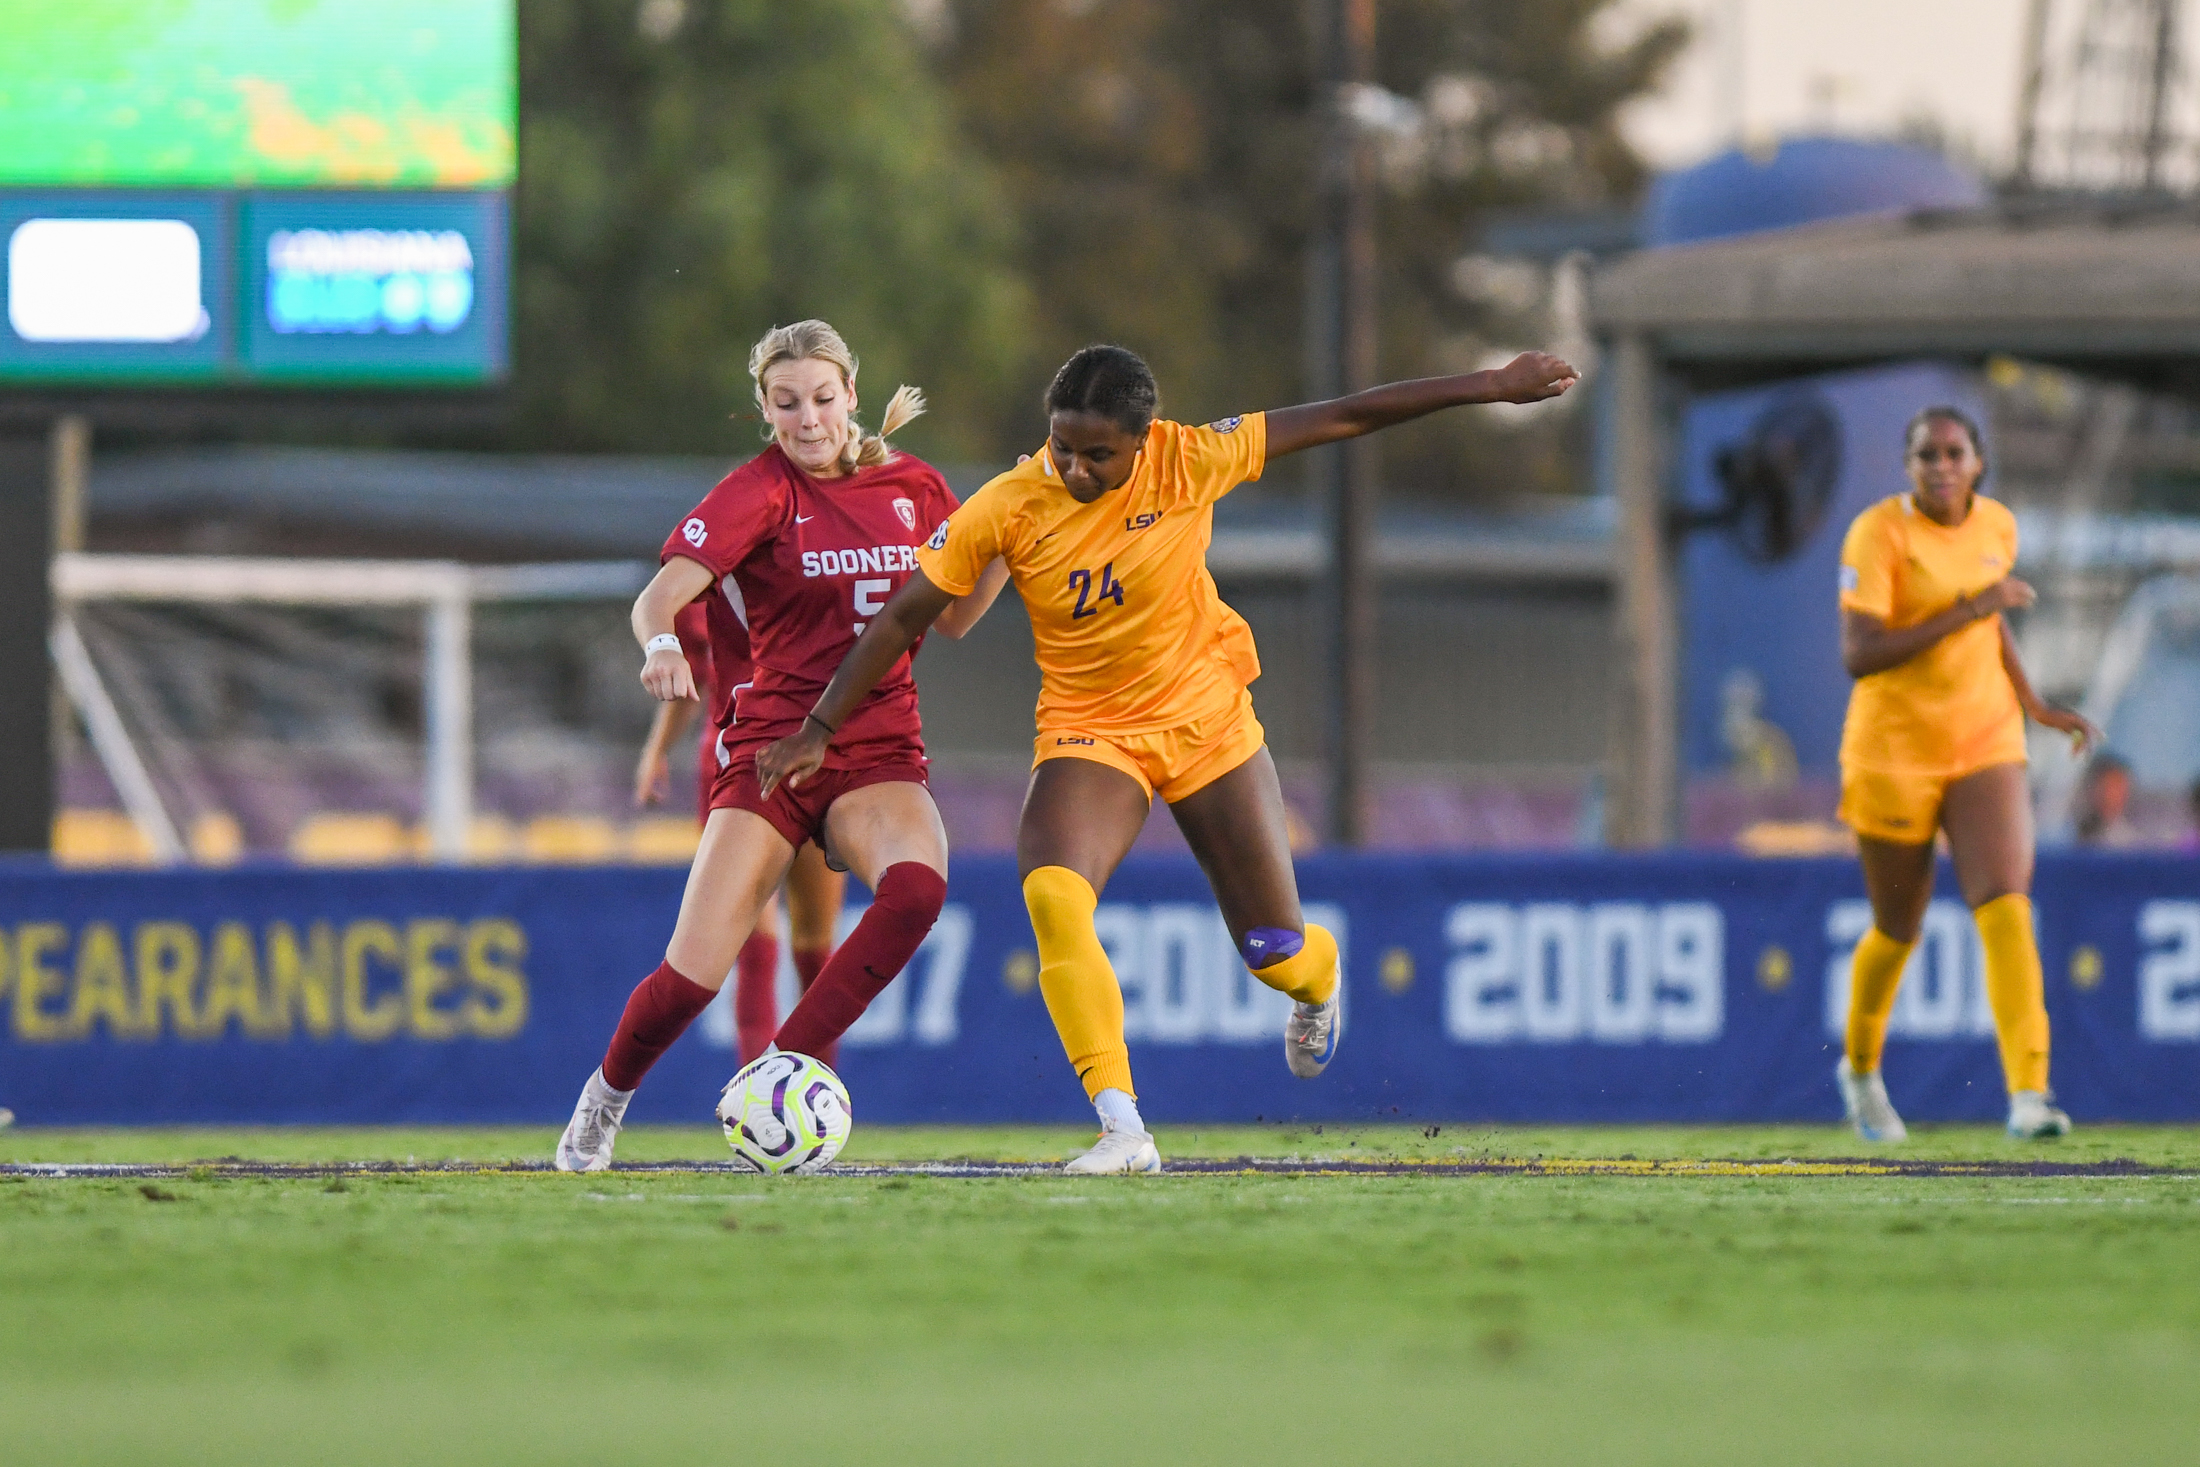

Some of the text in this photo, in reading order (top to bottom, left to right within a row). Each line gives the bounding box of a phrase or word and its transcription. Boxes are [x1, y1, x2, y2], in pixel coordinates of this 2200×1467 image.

[853, 578, 892, 637] 5
[1069, 561, 1124, 620] 24
[1056, 737, 1095, 746] LSU
[1444, 902, 1726, 1045] 2009
